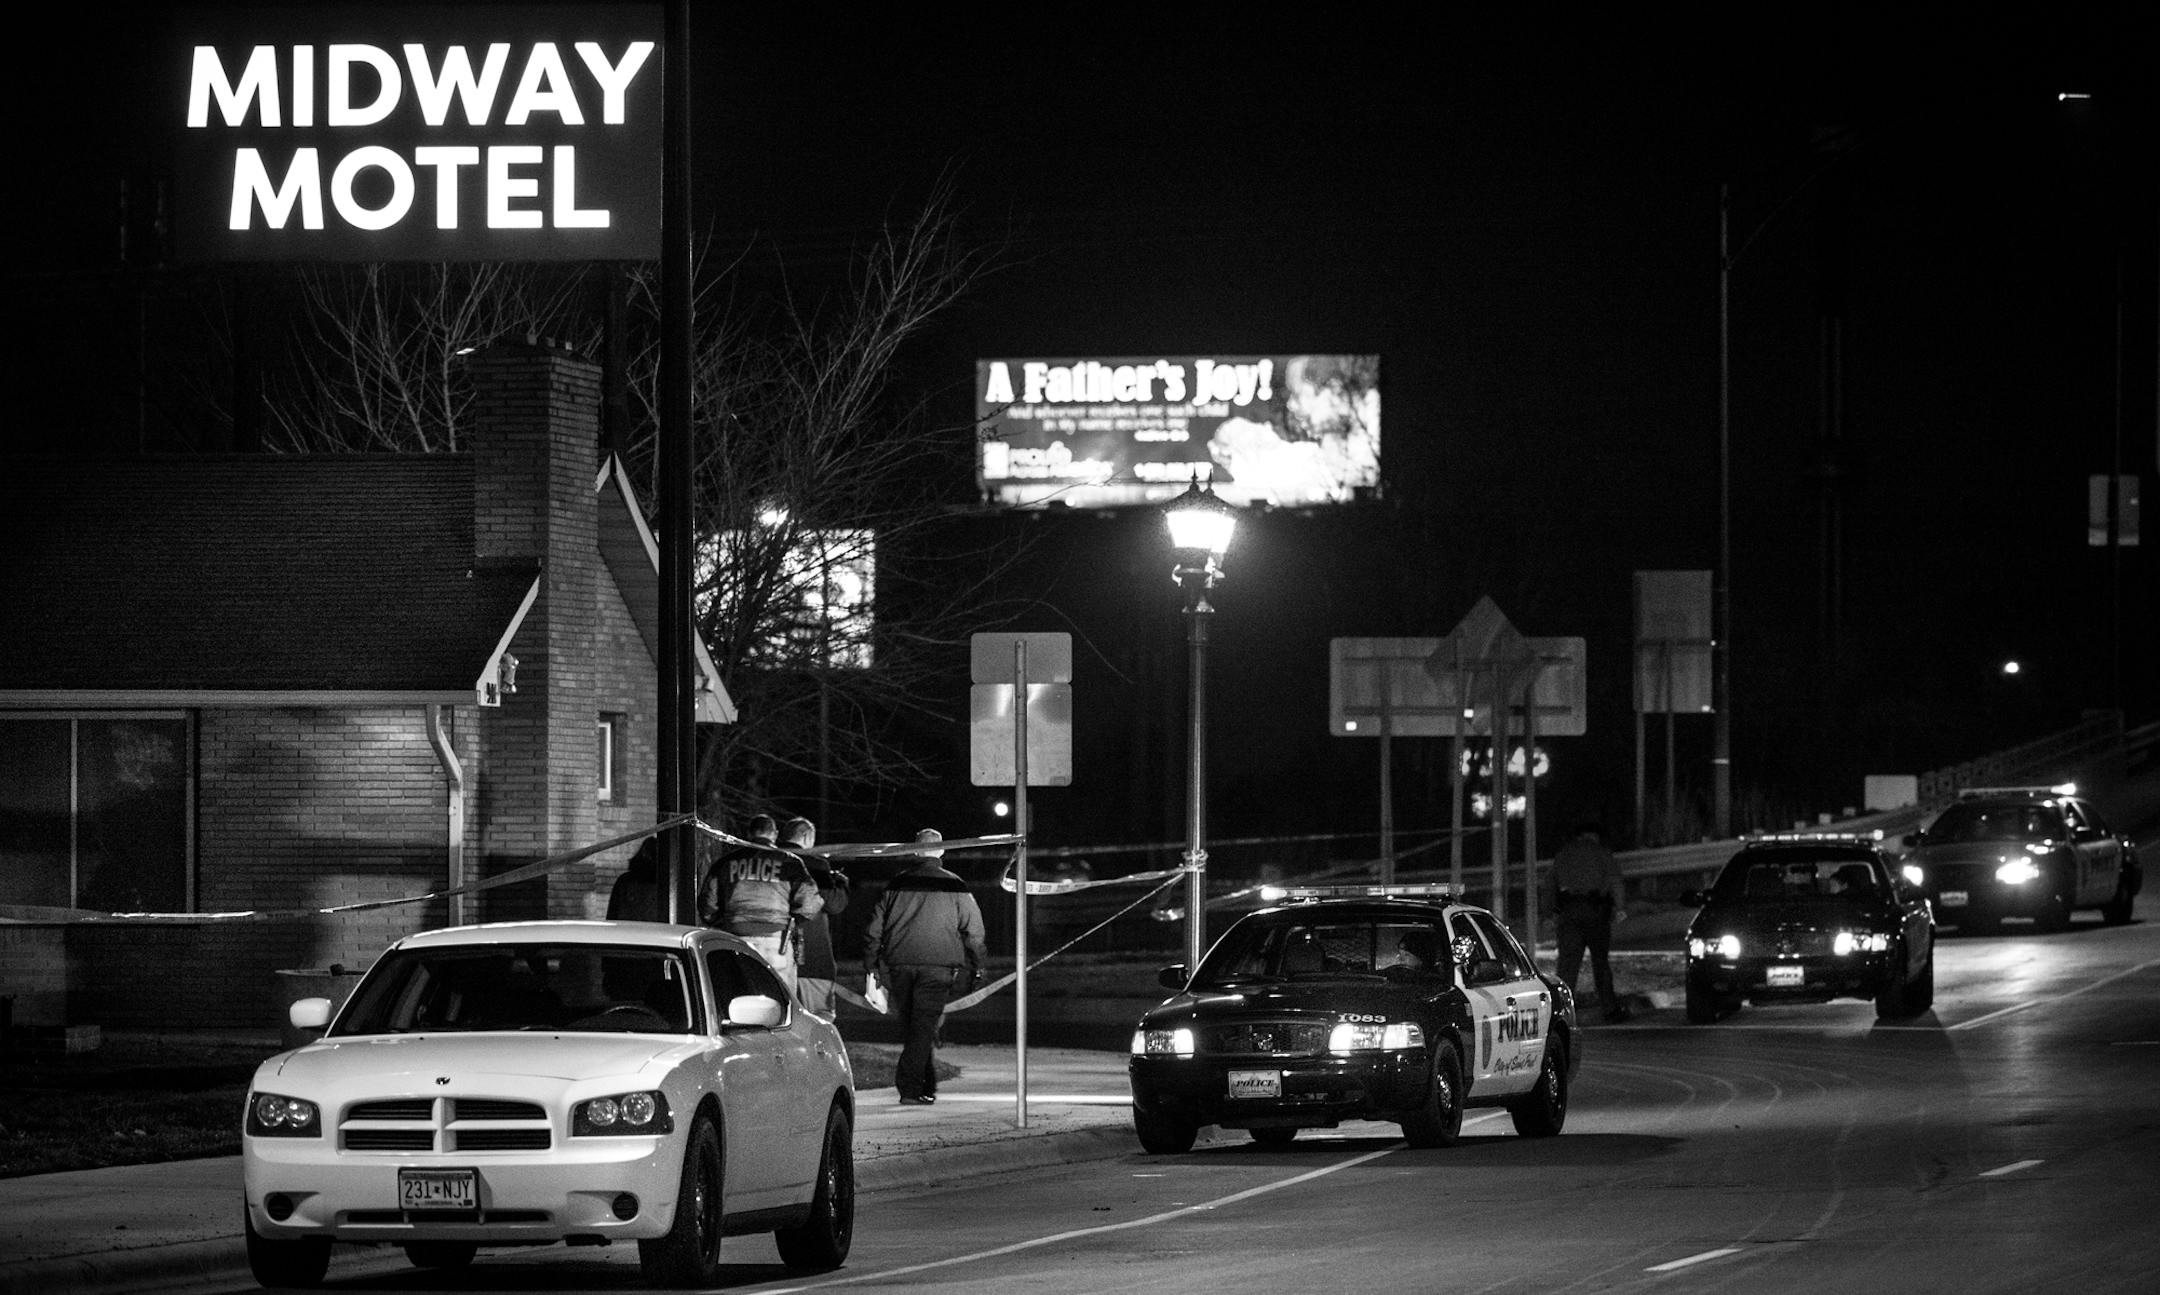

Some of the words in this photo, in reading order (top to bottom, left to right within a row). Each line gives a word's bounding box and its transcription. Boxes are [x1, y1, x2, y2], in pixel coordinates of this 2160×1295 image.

[187, 41, 655, 127] MIDWAY
[229, 145, 610, 231] MOTEL
[985, 361, 1015, 402] A
[1022, 360, 1186, 403] Father's
[1192, 358, 1274, 406] Joy!
[729, 858, 782, 883] POLICE
[1498, 1008, 1539, 1043] POLICE
